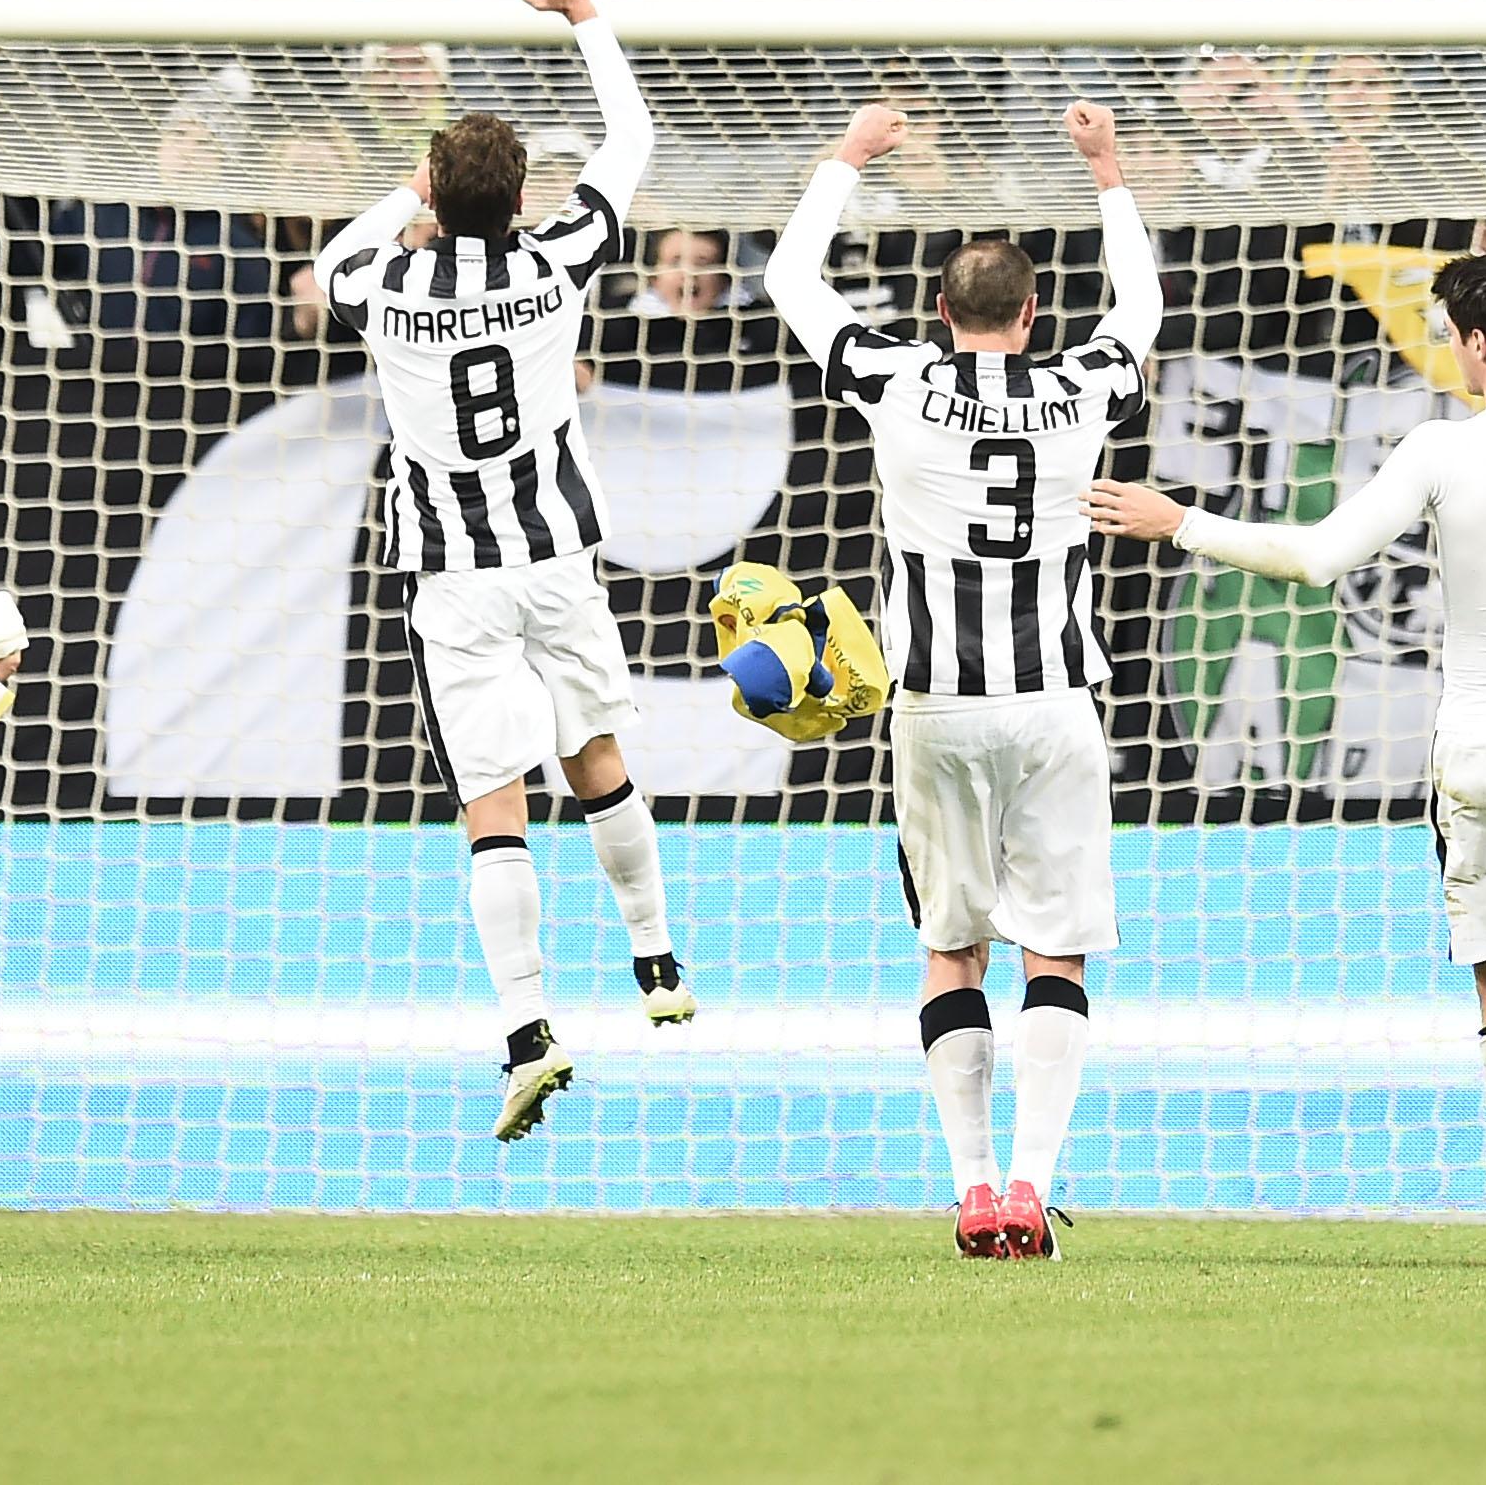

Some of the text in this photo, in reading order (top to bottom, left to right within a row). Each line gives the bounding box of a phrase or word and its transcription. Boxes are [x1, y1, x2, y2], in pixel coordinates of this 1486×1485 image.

[383, 286, 563, 344] MARCHISIO
[449, 344, 521, 460] 8
[920, 390, 1083, 435] CHIELLINI
[968, 439, 1036, 559] 3
